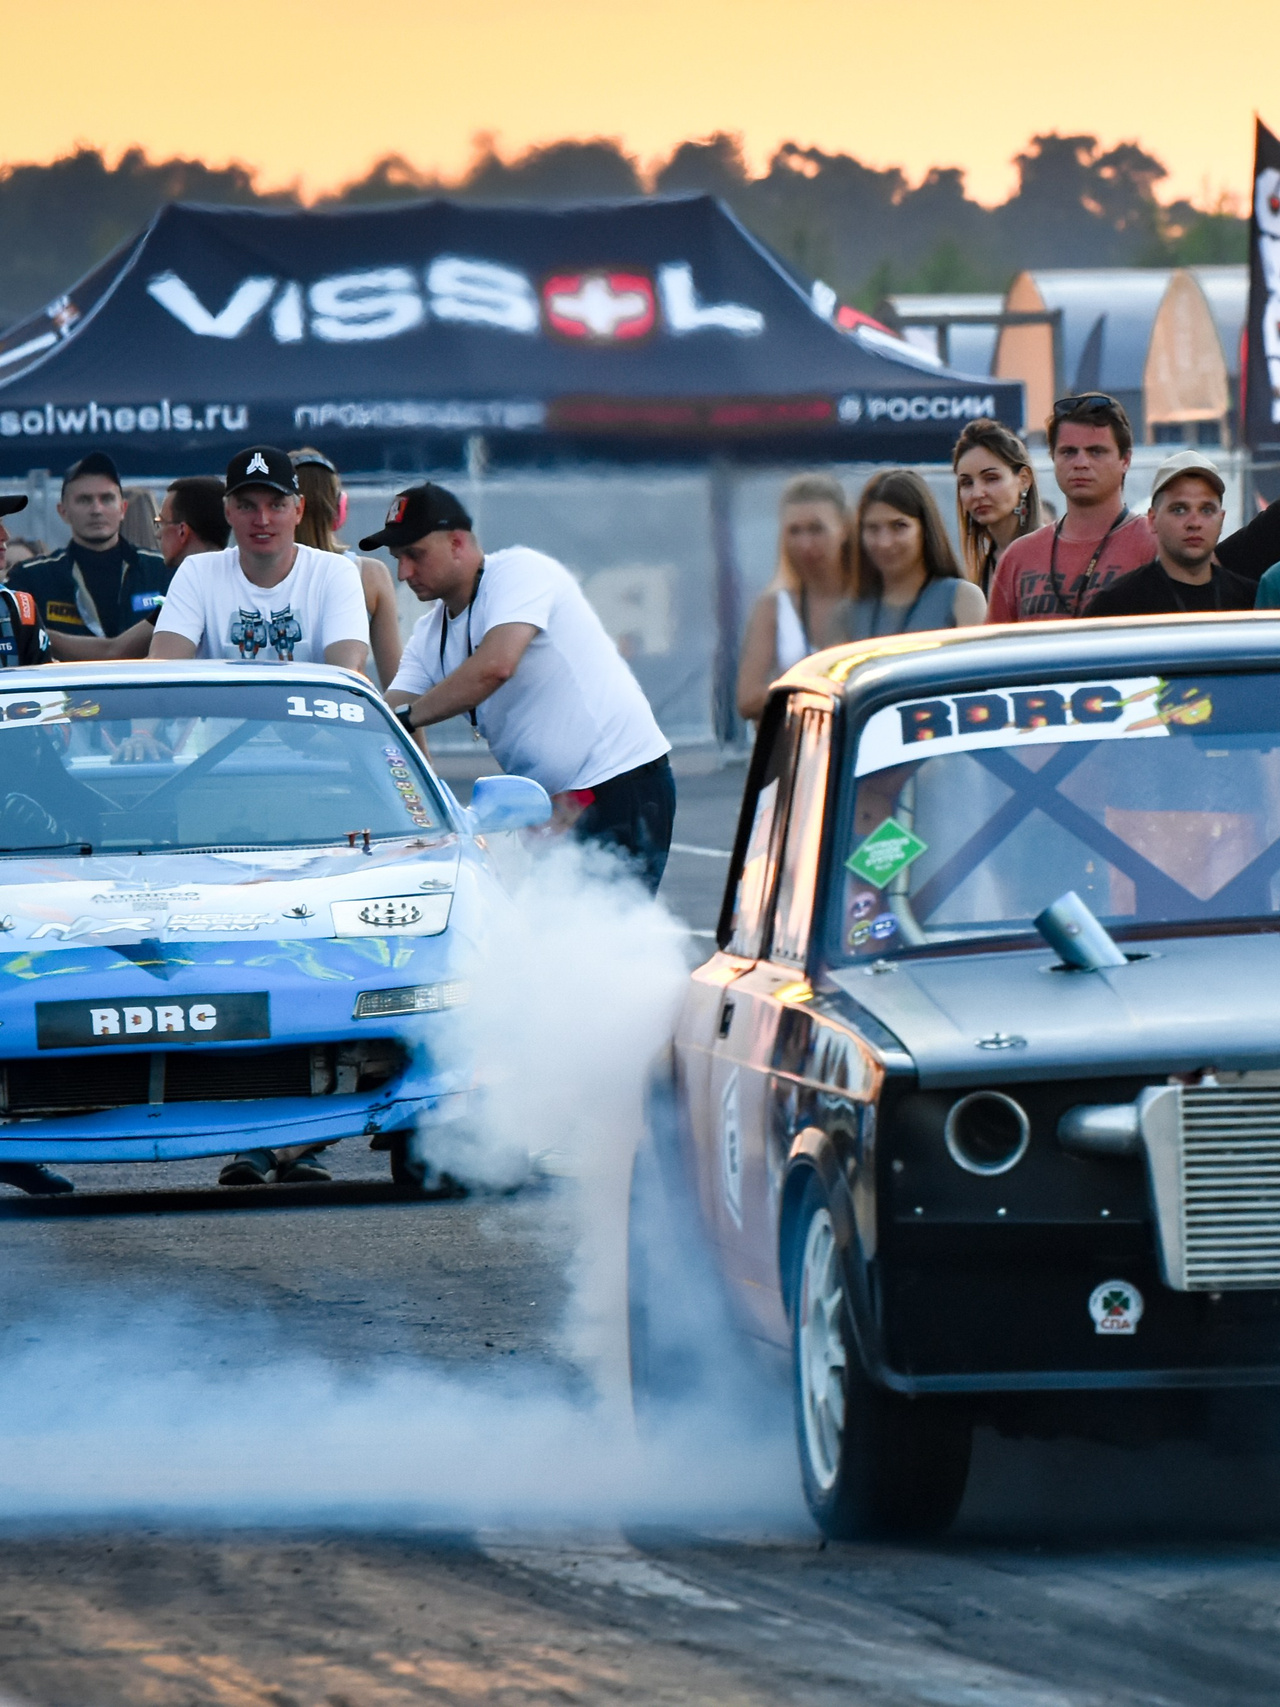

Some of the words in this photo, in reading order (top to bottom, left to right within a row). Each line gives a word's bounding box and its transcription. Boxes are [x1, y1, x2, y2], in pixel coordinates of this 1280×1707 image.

[867, 393, 998, 422] РОССИИ
[287, 696, 365, 723] 138
[897, 686, 1124, 746] RDRC
[89, 1003, 218, 1036] RDRC
